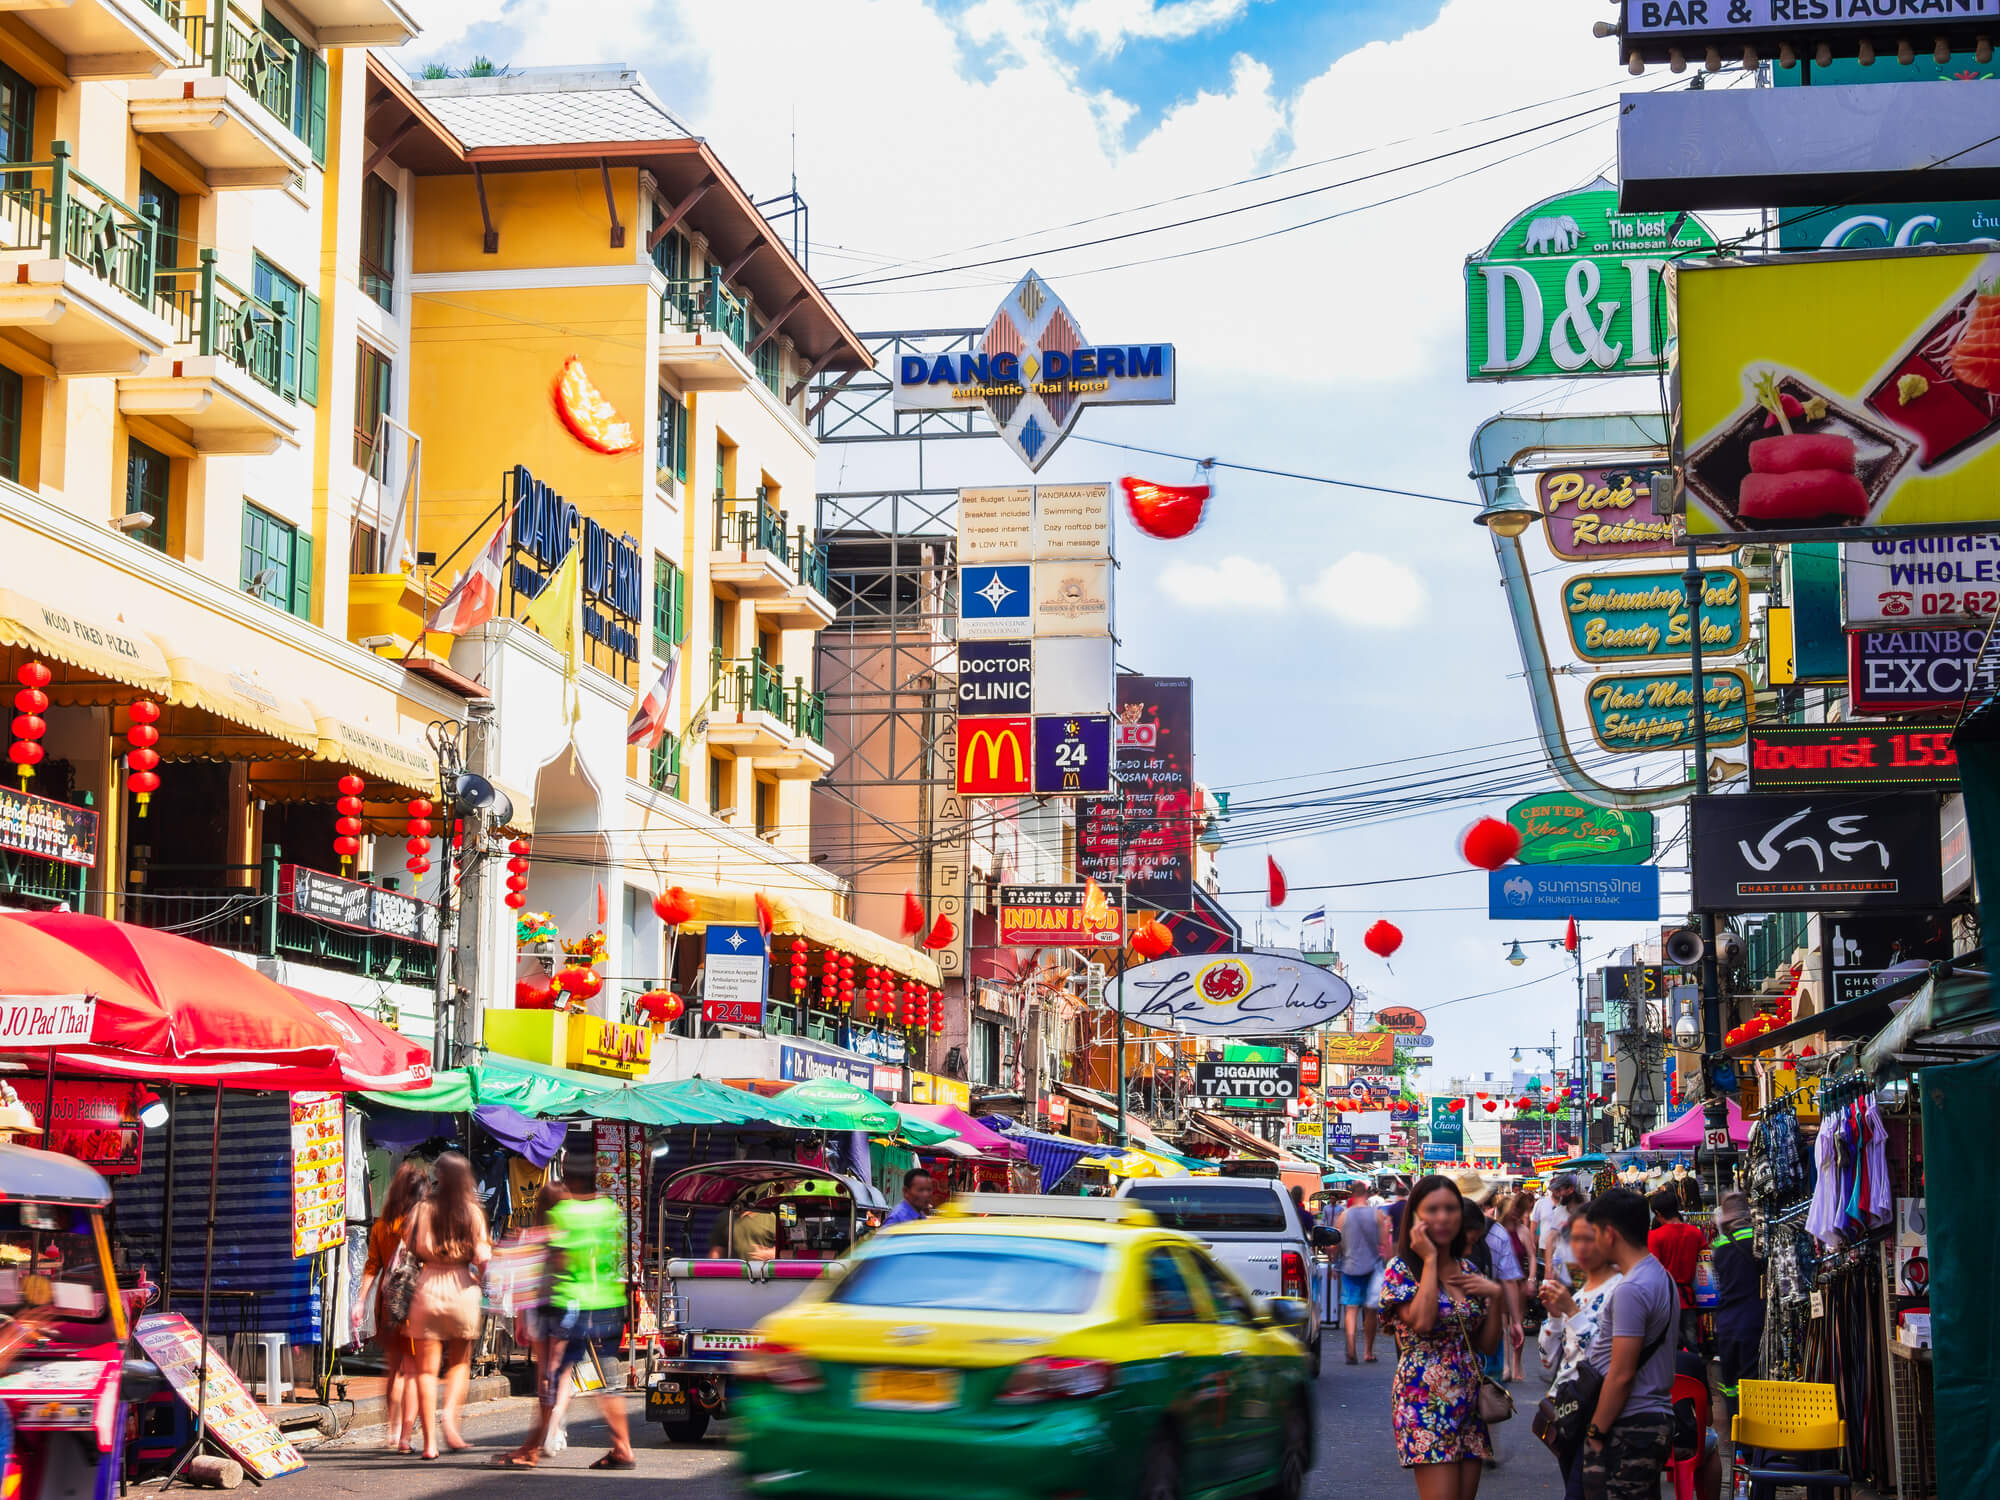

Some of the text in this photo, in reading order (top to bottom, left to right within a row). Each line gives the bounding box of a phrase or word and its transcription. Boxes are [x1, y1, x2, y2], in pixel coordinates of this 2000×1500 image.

[1641, 0, 1985, 28] BAR & RESTAURANT
[1609, 218, 1666, 239] The best
[1593, 242, 1608, 251] on
[1612, 239, 1666, 250] Khaosan
[901, 346, 1163, 386] DANG DERM
[952, 379, 1109, 400] Authentic Thai Hotel
[962, 495, 1032, 504] Best Budget Luxury
[1038, 491, 1106, 499] PANORAMA-VIEW
[965, 510, 1030, 519] Breakfast included
[1044, 507, 1083, 516] Swimming
[967, 527, 999, 535] hi-speed
[1044, 524, 1062, 532] Cozy
[1064, 523, 1093, 531] rooftop
[1569, 582, 1683, 616] Swimming
[41, 608, 140, 659] WOOD FIRED PIZZA
[1585, 618, 1660, 652] Beauty
[1865, 631, 1992, 654] RAINBO
[960, 658, 1031, 674] DOCTOR
[959, 681, 1030, 701] CLINIC
[1593, 683, 1742, 712] Thai Masage
[1116, 726, 1154, 745] EO
[1603, 713, 1685, 742] Shopping
[1055, 744, 1088, 767] 24
[1753, 737, 1879, 770] tourist
[1143, 759, 1164, 769] LIST
[1152, 771, 1183, 782] ROAD:
[1100, 808, 1152, 816] GET TATTOO
[1520, 805, 1586, 819] CENTER
[1520, 818, 1620, 839] Khao Sarn
[1138, 857, 1158, 866] YOU
[1092, 870, 1115, 881] JUST
[1147, 870, 1174, 880] FUN!
[1538, 879, 1641, 897] ธนาคารกรุงไทย
[1740, 884, 1777, 893] CHART
[1782, 884, 1804, 892] BAR
[1821, 882, 1895, 891] RESTAURANT
[1008, 892, 1051, 904] TASTE
[1054, 892, 1072, 904] OF
[1538, 896, 1620, 904] KRUNGTHAI BANK
[1004, 908, 1068, 929] INDIAN
[1844, 976, 1888, 986] CHART
[1134, 971, 1337, 1018] The Club
[716, 1003, 743, 1021] 24
[1380, 1013, 1416, 1027] Buddy
[3, 1005, 90, 1036] JO Pad Thai
[1404, 1037, 1420, 1045] INN
[794, 1051, 805, 1077] Dr.
[1302, 1061, 1318, 1071] BAG
[1215, 1065, 1280, 1080] BIGGAINK
[1202, 1079, 1293, 1097] TATTOO
[1370, 1087, 1388, 1095] Plaza
[77, 1098, 117, 1121] Padthai
[1335, 1124, 1351, 1135] CARD
[1433, 1121, 1461, 1131] Chang
[651, 1390, 686, 1406] 4x4
